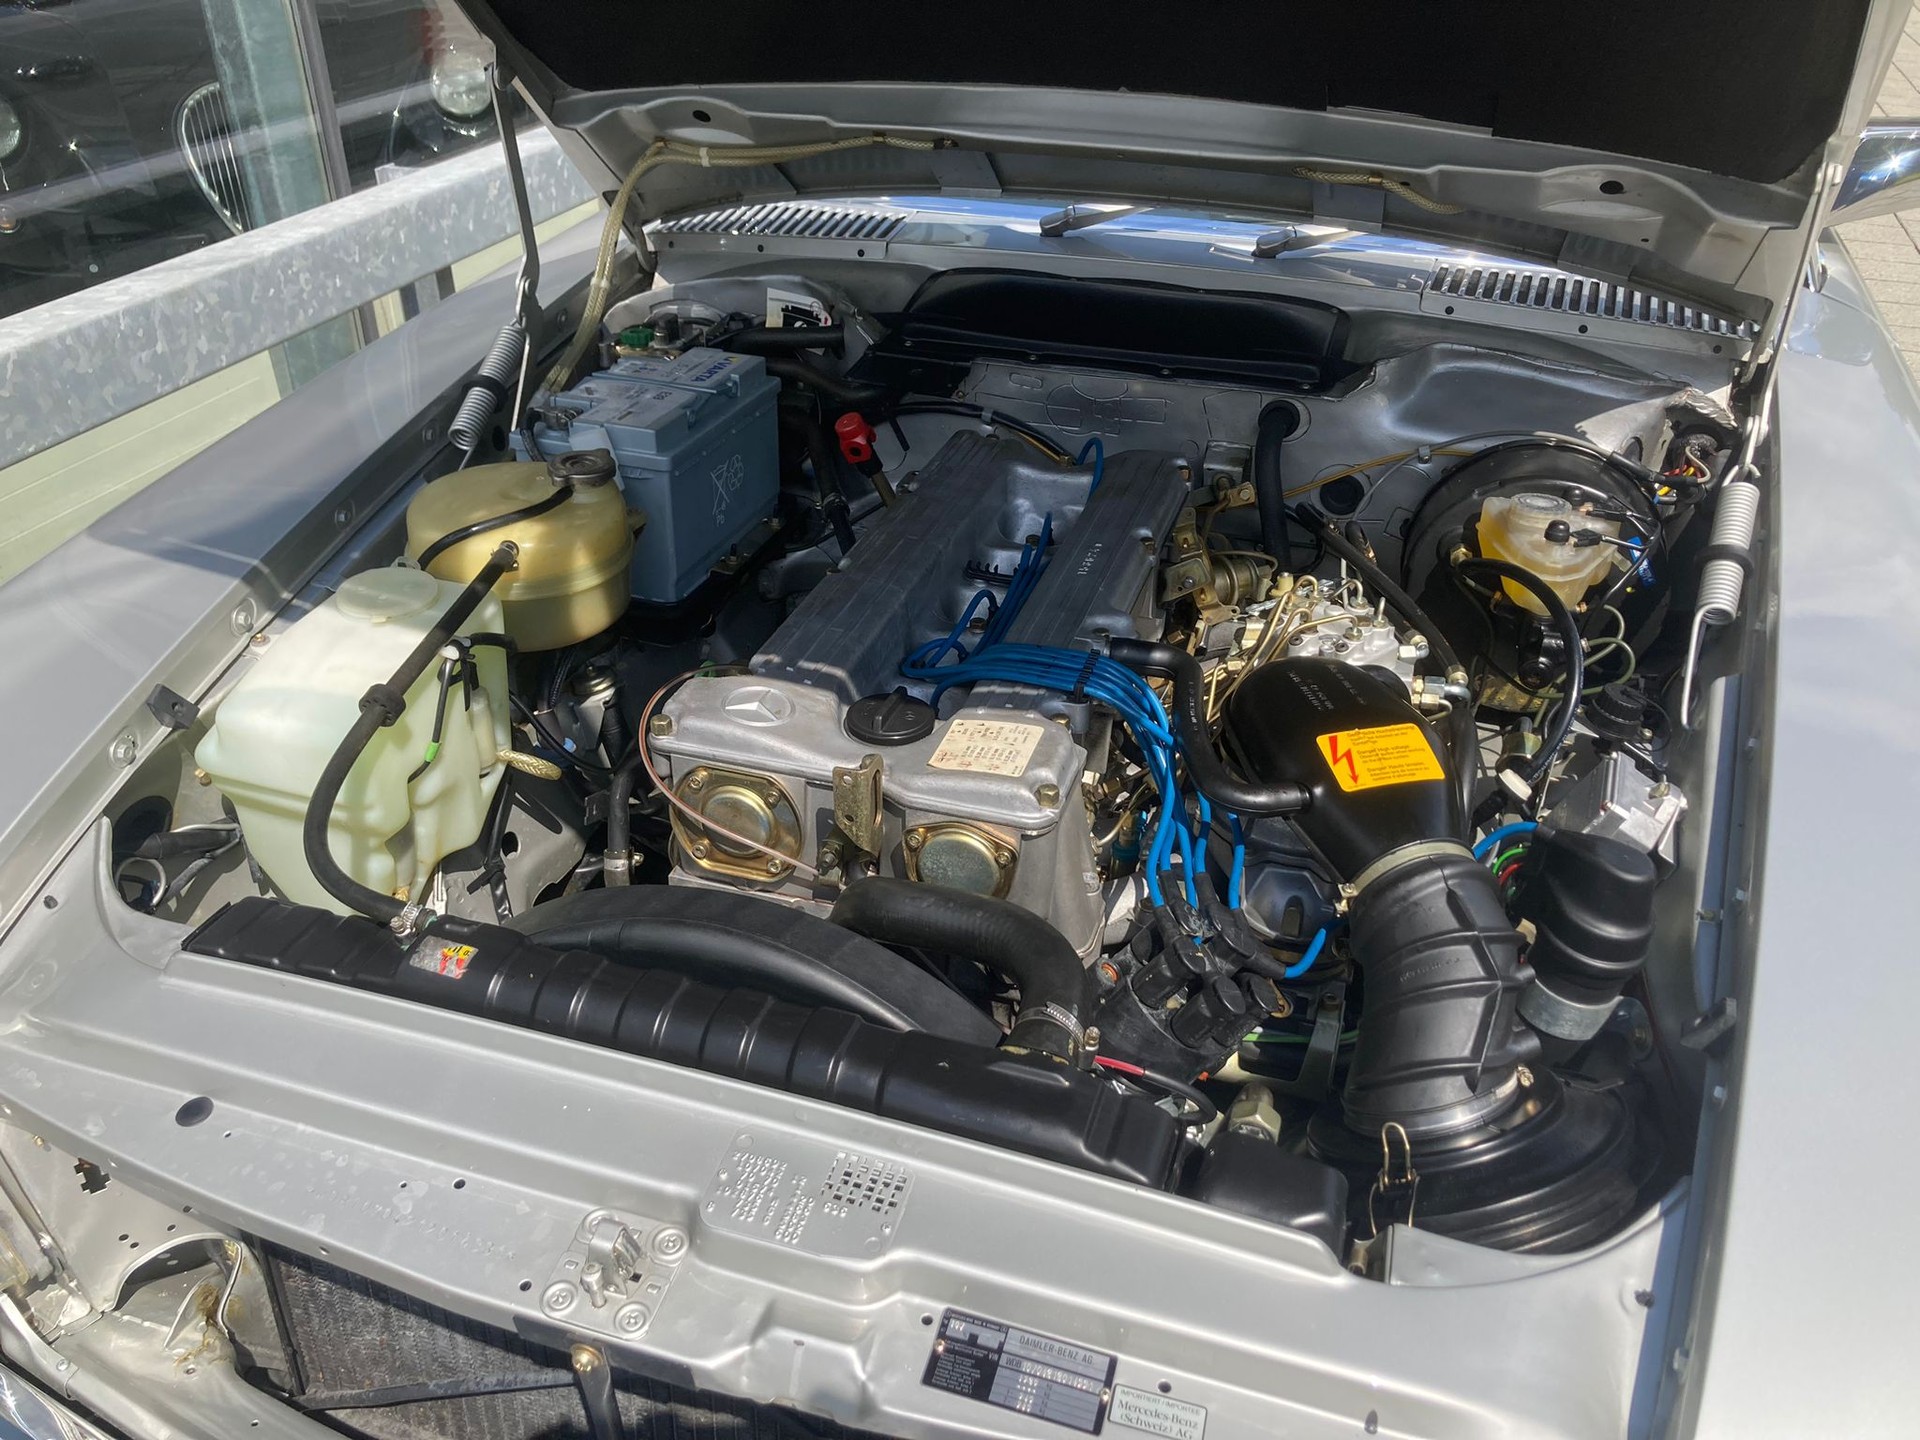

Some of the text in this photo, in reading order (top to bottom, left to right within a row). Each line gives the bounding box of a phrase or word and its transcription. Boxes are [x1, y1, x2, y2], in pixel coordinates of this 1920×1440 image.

[691, 360, 732, 382] VARTA
[1020, 1335, 1079, 1361] DAIMLER-BENZ
[1006, 1356, 1021, 1368] WDB
[1118, 1399, 1198, 1429] Mercedes-Benz
[1120, 1412, 1193, 1440] (Schweiz) AG
